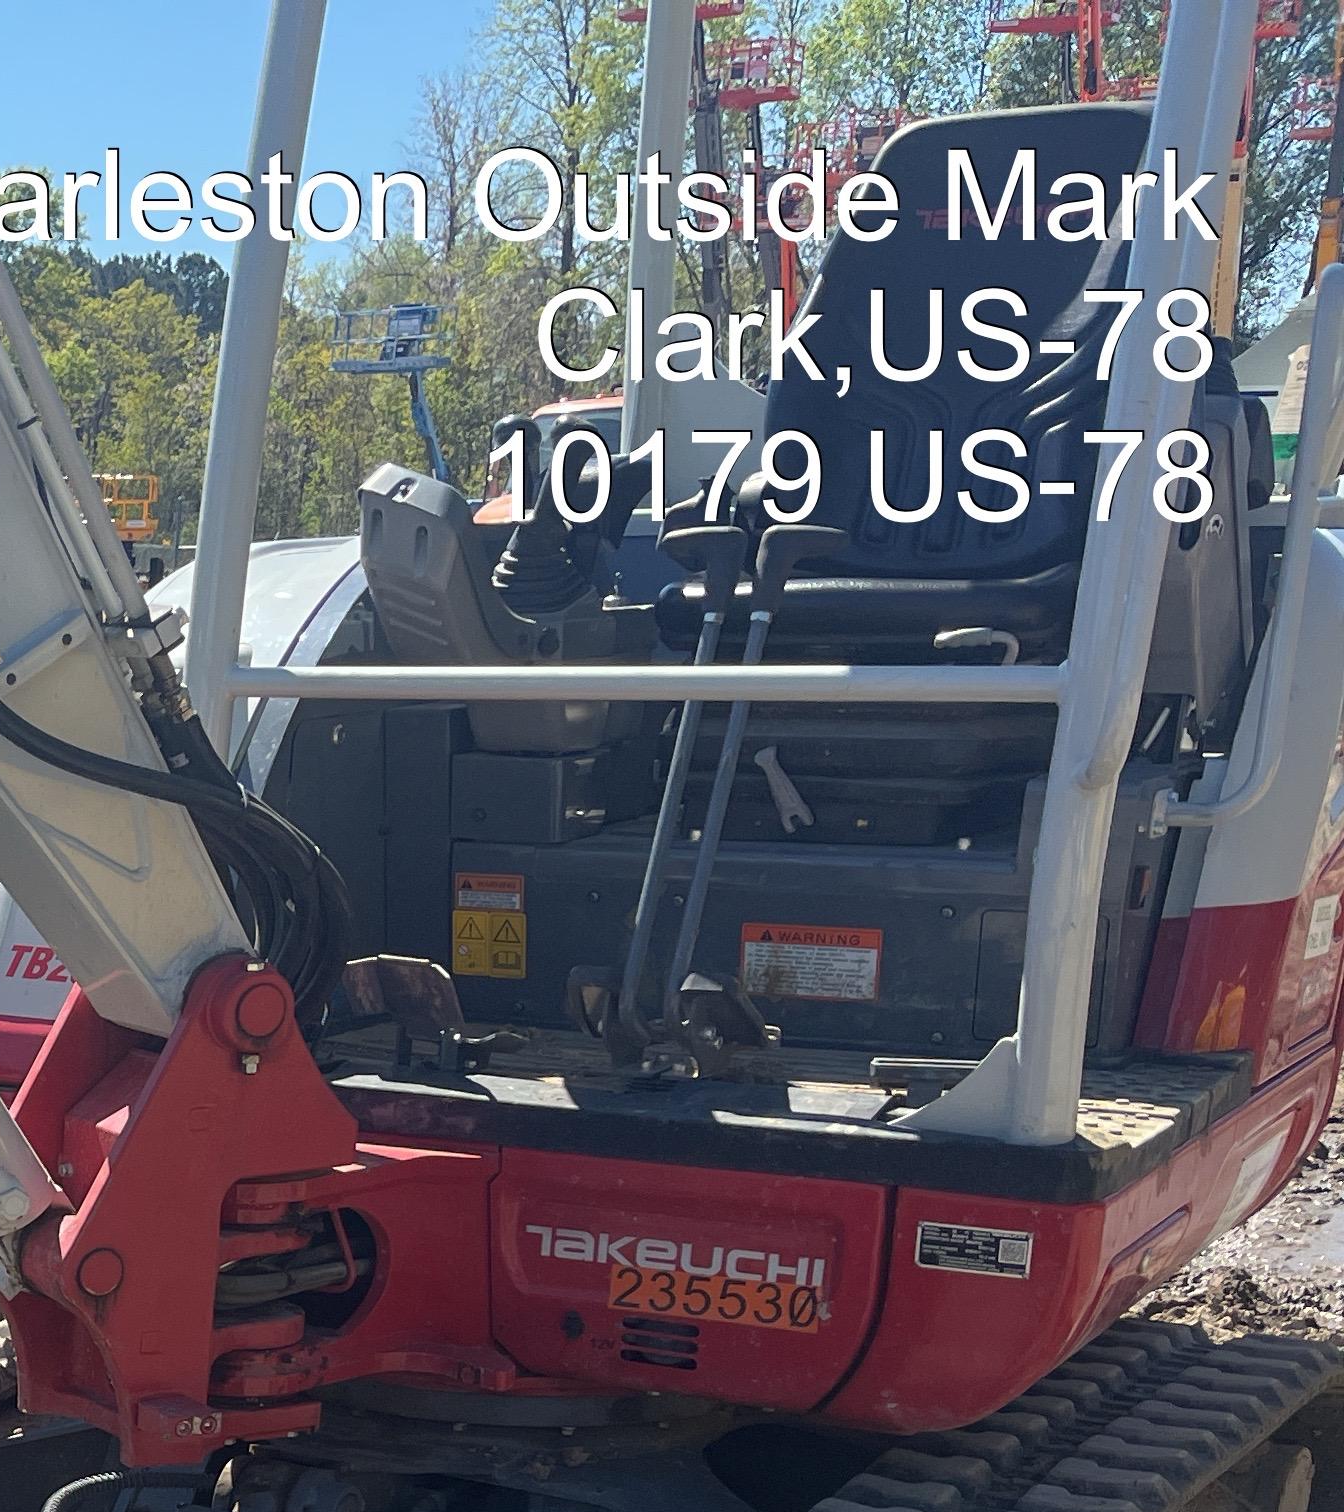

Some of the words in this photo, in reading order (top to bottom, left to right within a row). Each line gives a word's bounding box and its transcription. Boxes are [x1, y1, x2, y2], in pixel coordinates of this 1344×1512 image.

[778, 930, 861, 946] WARNING
[5, 944, 69, 983] TB2
[613, 1266, 817, 1328] 235530
